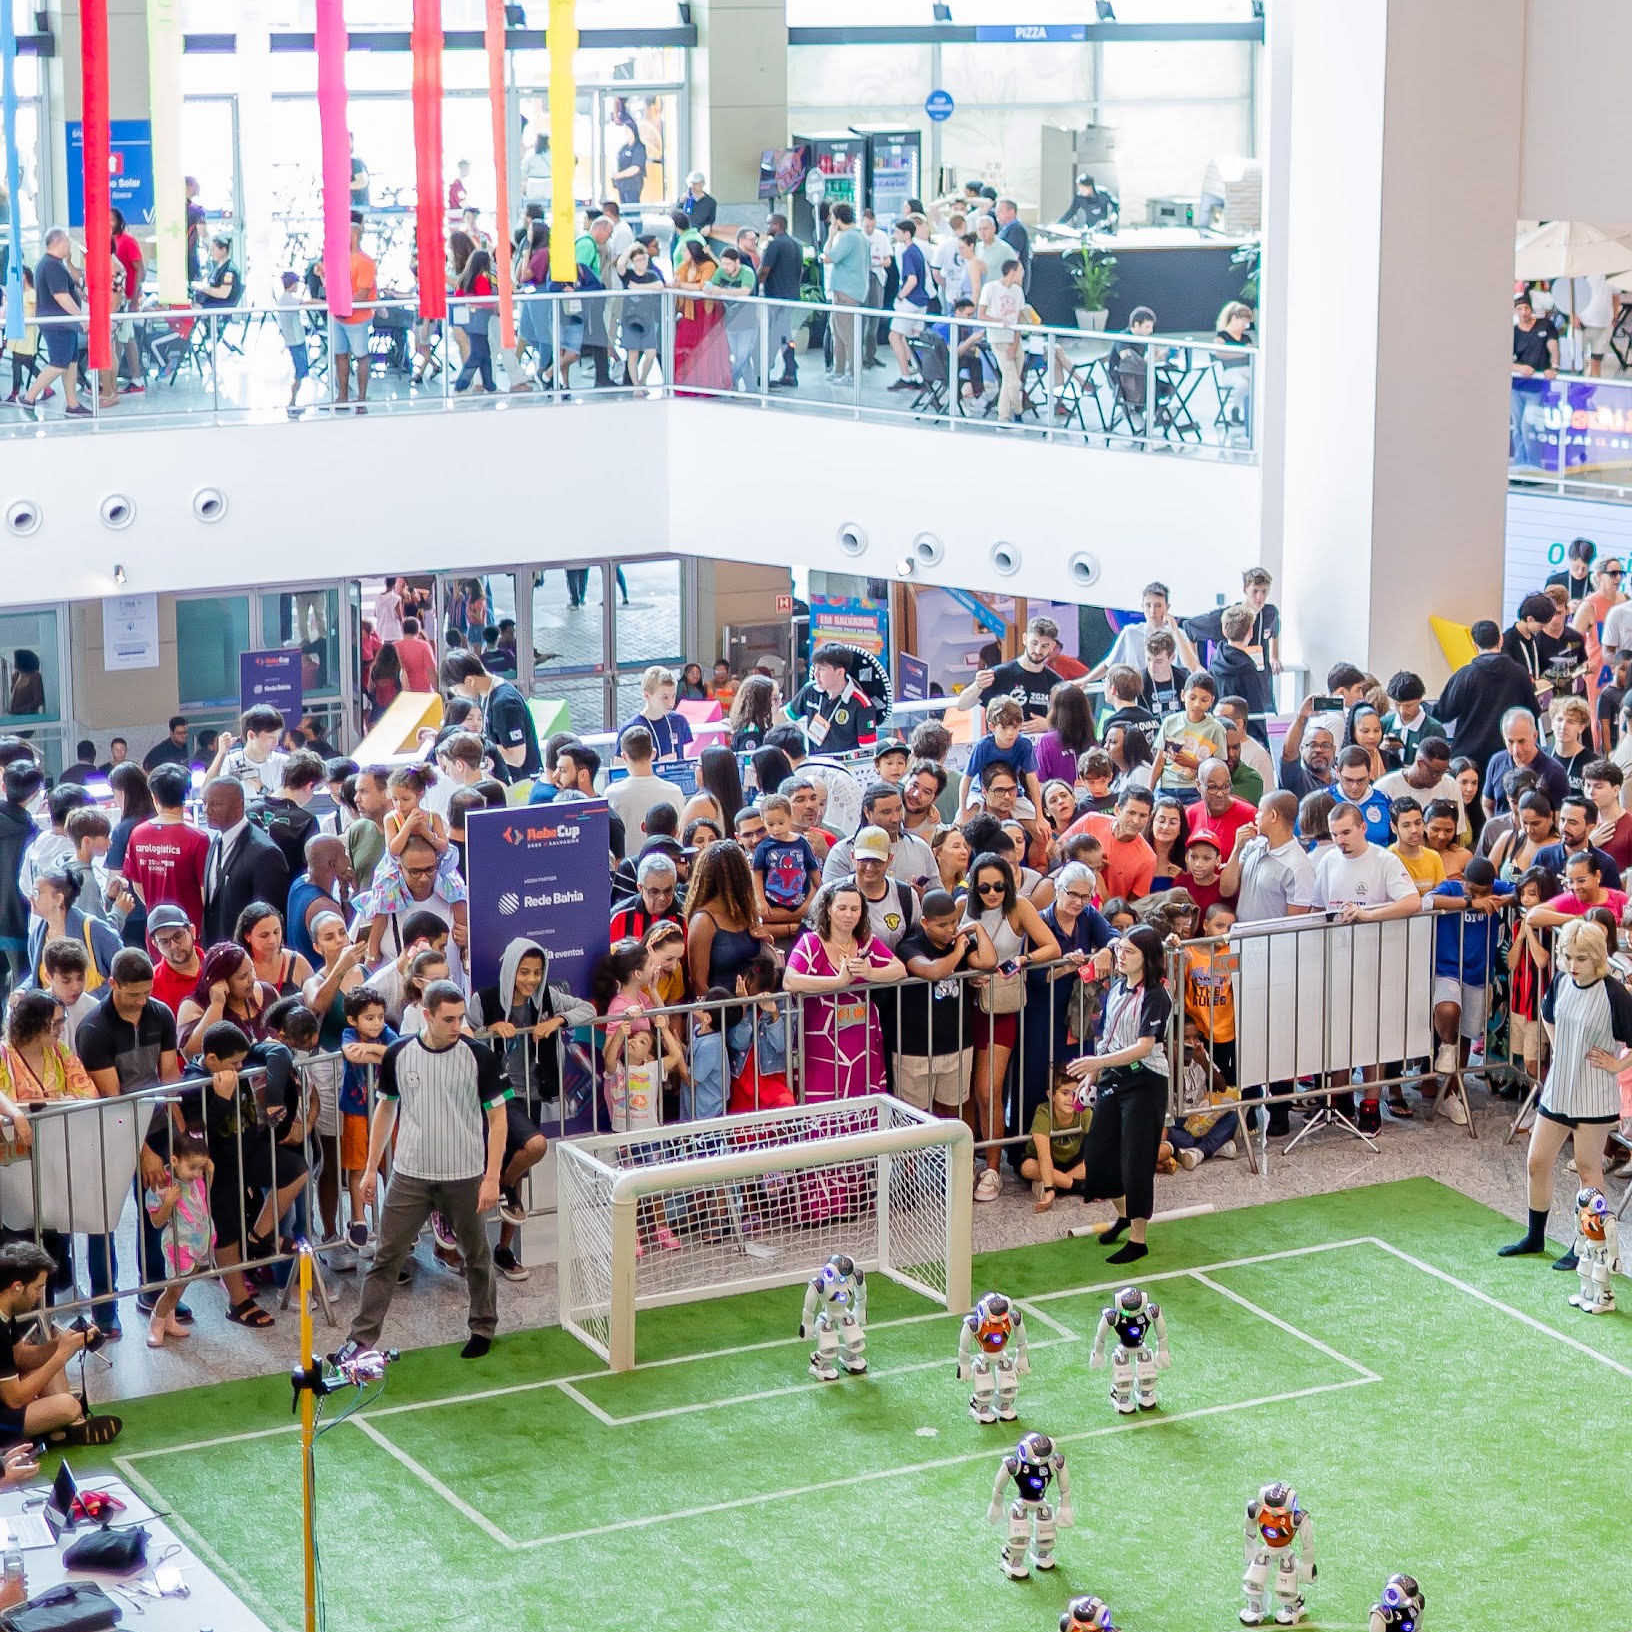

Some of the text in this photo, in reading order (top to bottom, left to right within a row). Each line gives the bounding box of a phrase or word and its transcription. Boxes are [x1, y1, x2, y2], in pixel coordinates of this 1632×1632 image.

[1015, 26, 1048, 40] PIZZA
[524, 889, 584, 908] Rede Bahia
[555, 947, 585, 959] eventos
